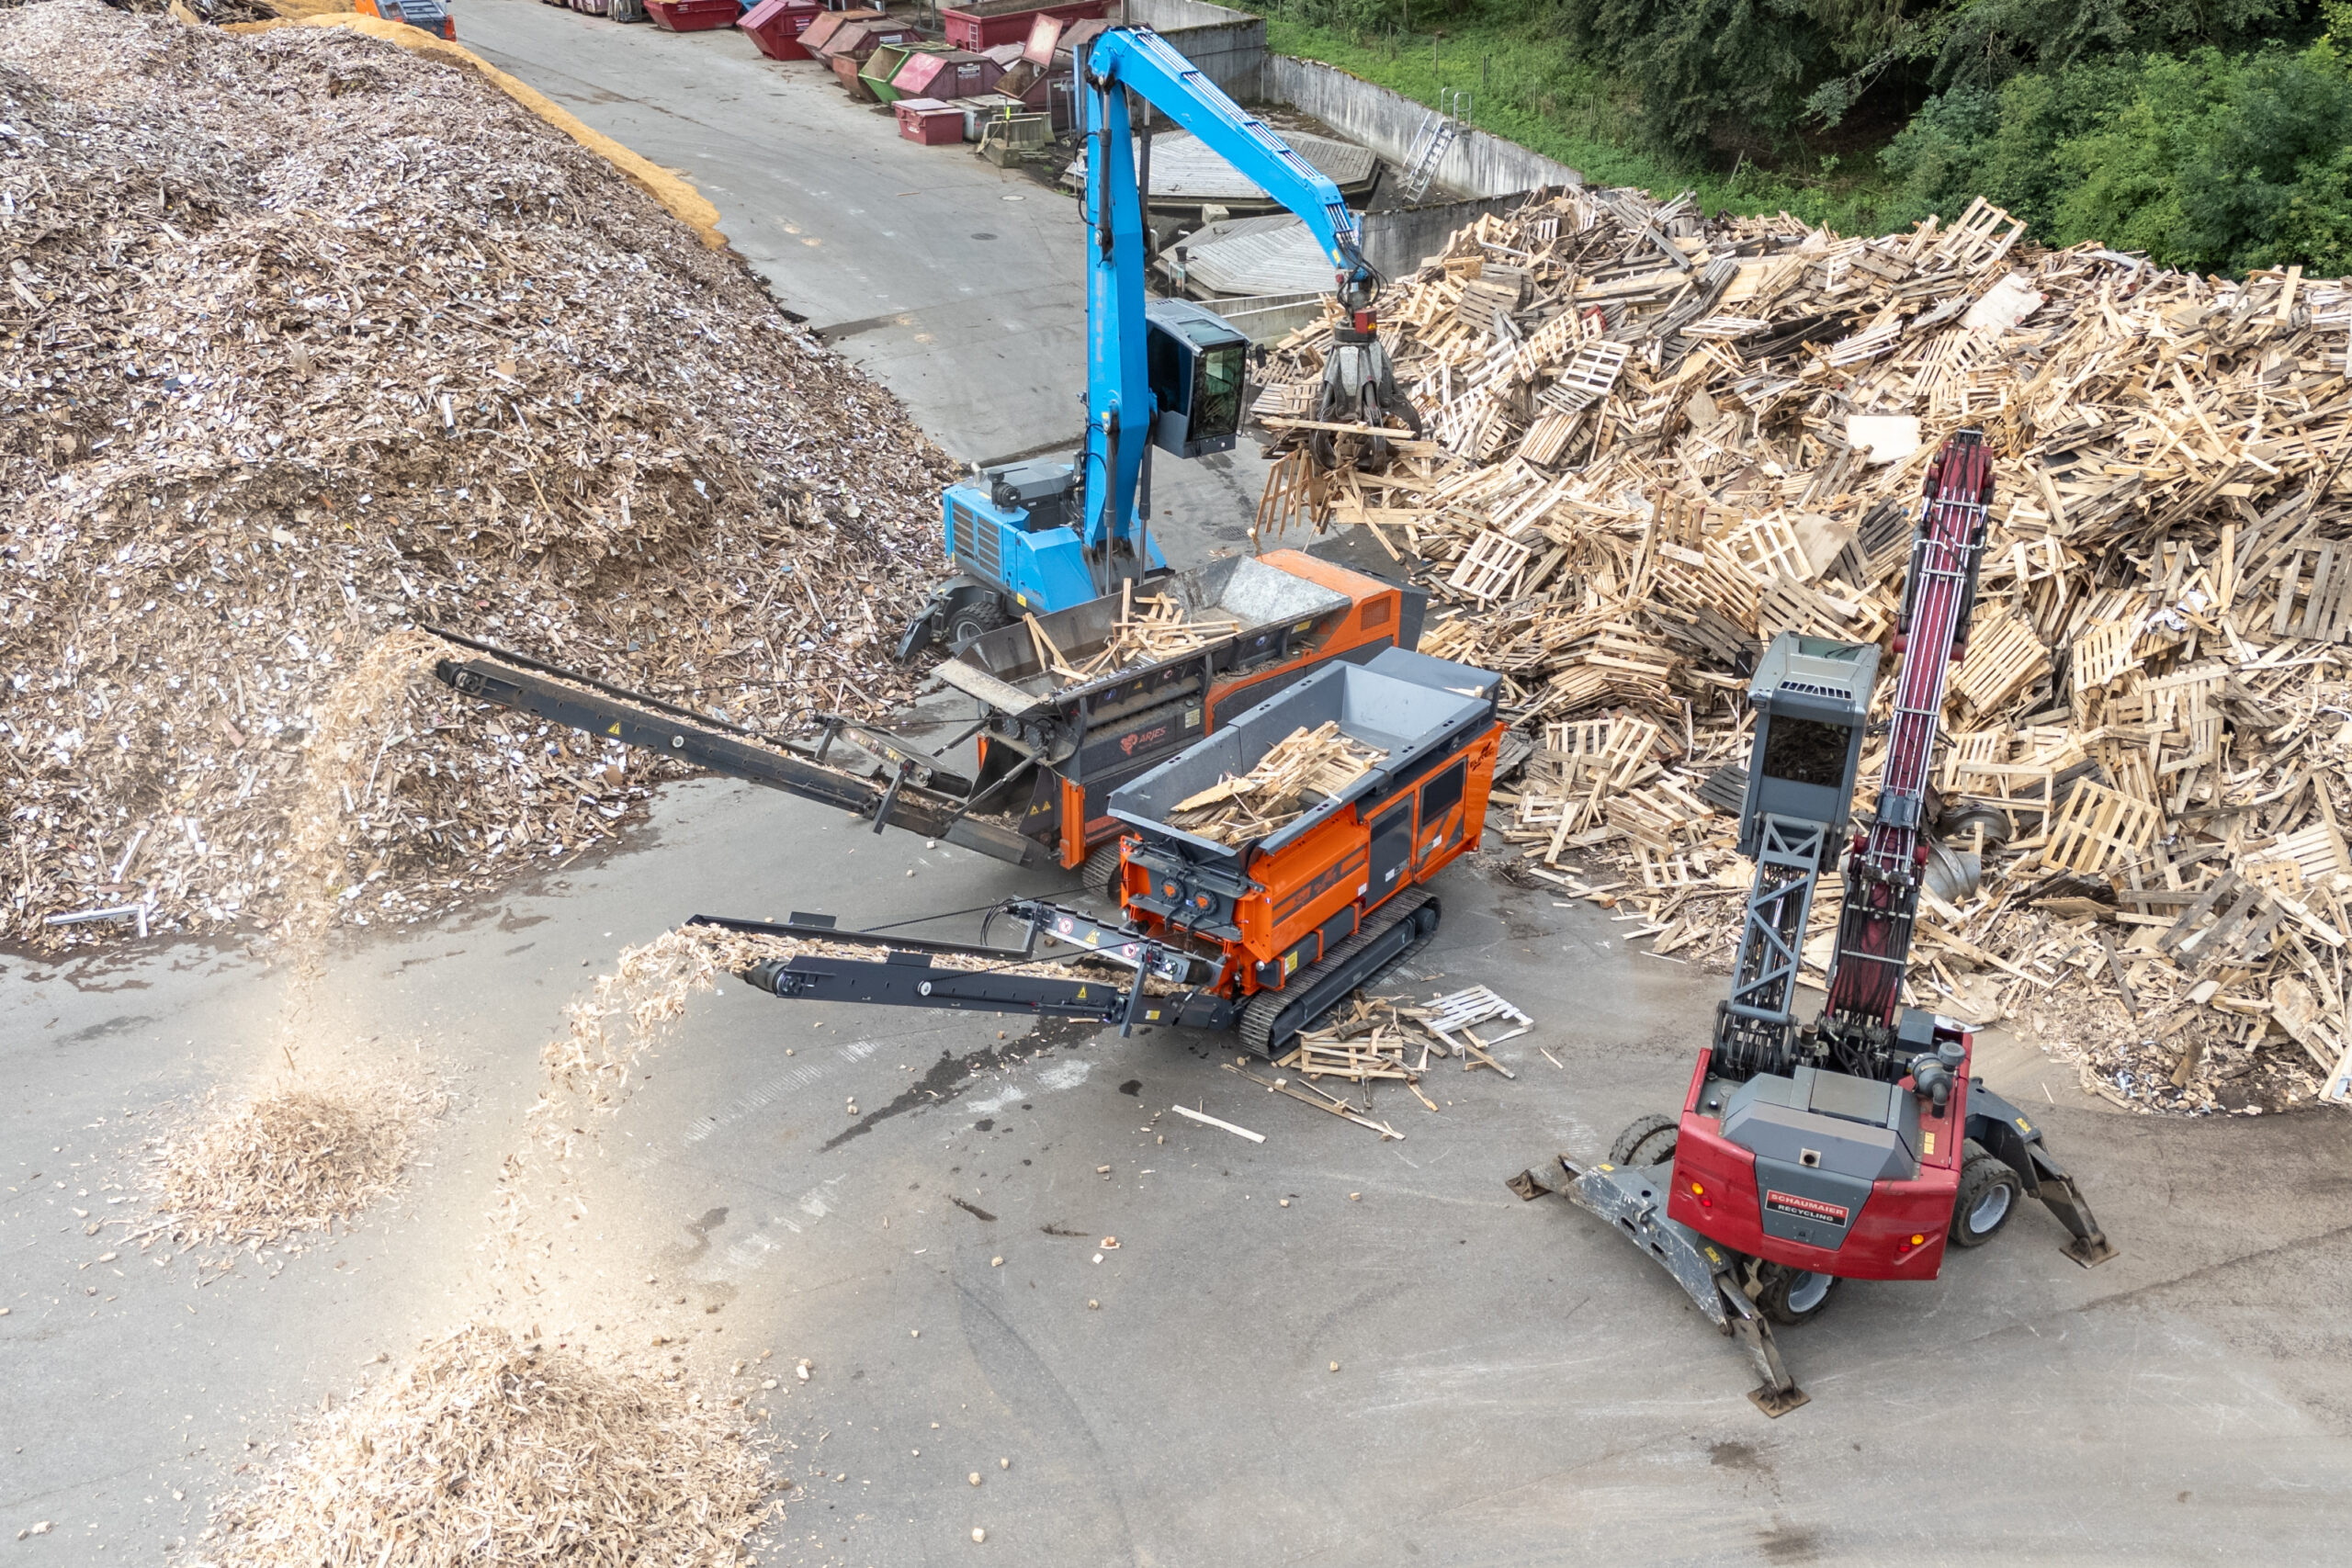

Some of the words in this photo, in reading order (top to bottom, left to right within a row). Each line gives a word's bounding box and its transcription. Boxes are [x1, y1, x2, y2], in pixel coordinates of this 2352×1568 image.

[1139, 726, 1167, 742] ARJES
[1770, 1193, 1844, 1215] SCHAUMAIER
[1778, 1203, 1834, 1222] RECYCLING
